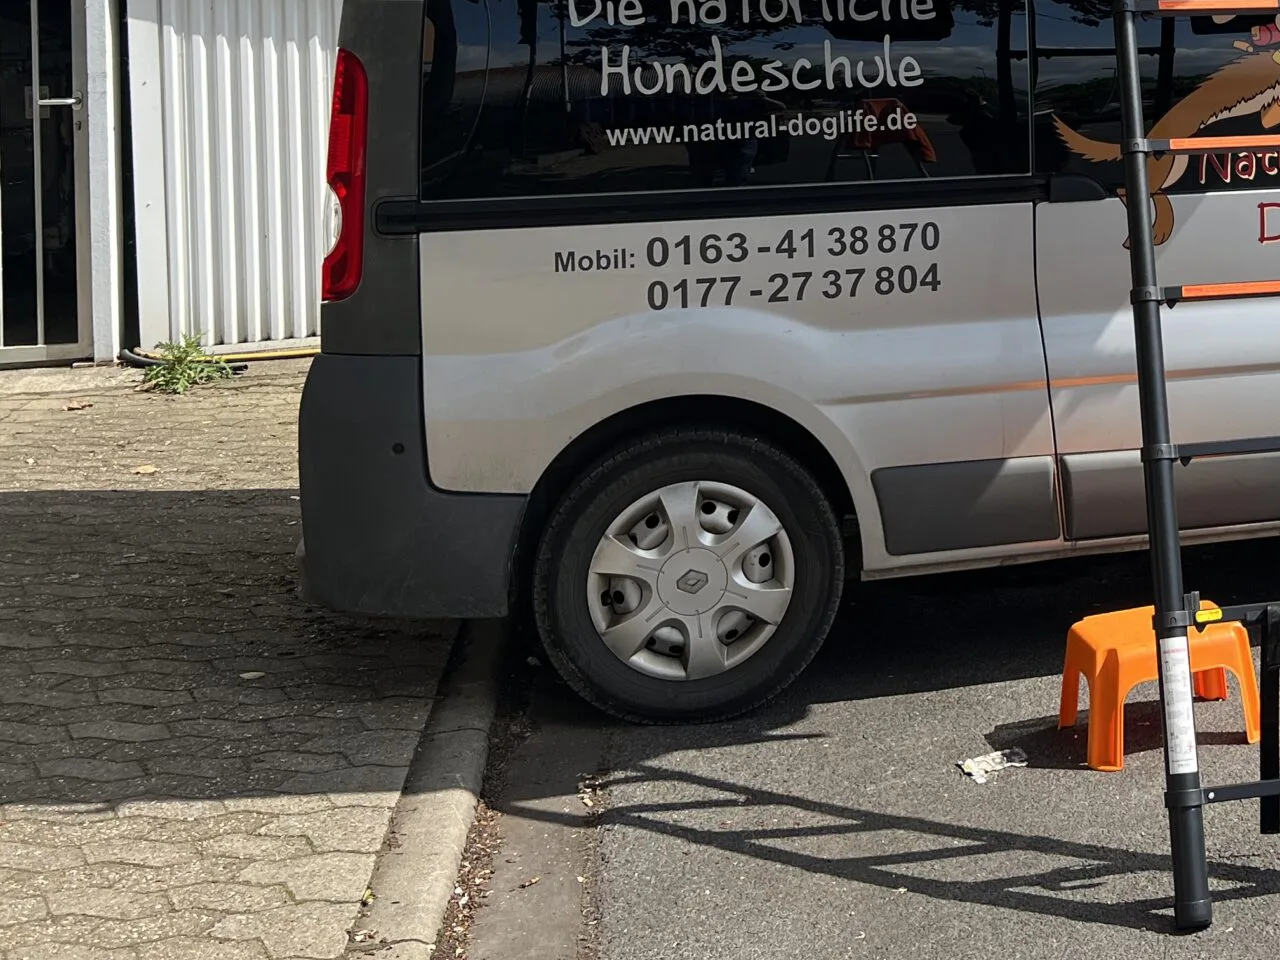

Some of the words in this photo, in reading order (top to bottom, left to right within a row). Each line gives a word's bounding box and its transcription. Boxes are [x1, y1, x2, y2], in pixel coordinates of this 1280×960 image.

[600, 35, 925, 97] Hundeschule
[606, 108, 918, 147] www.natural-doglife.de
[554, 246, 636, 273] Mobil:
